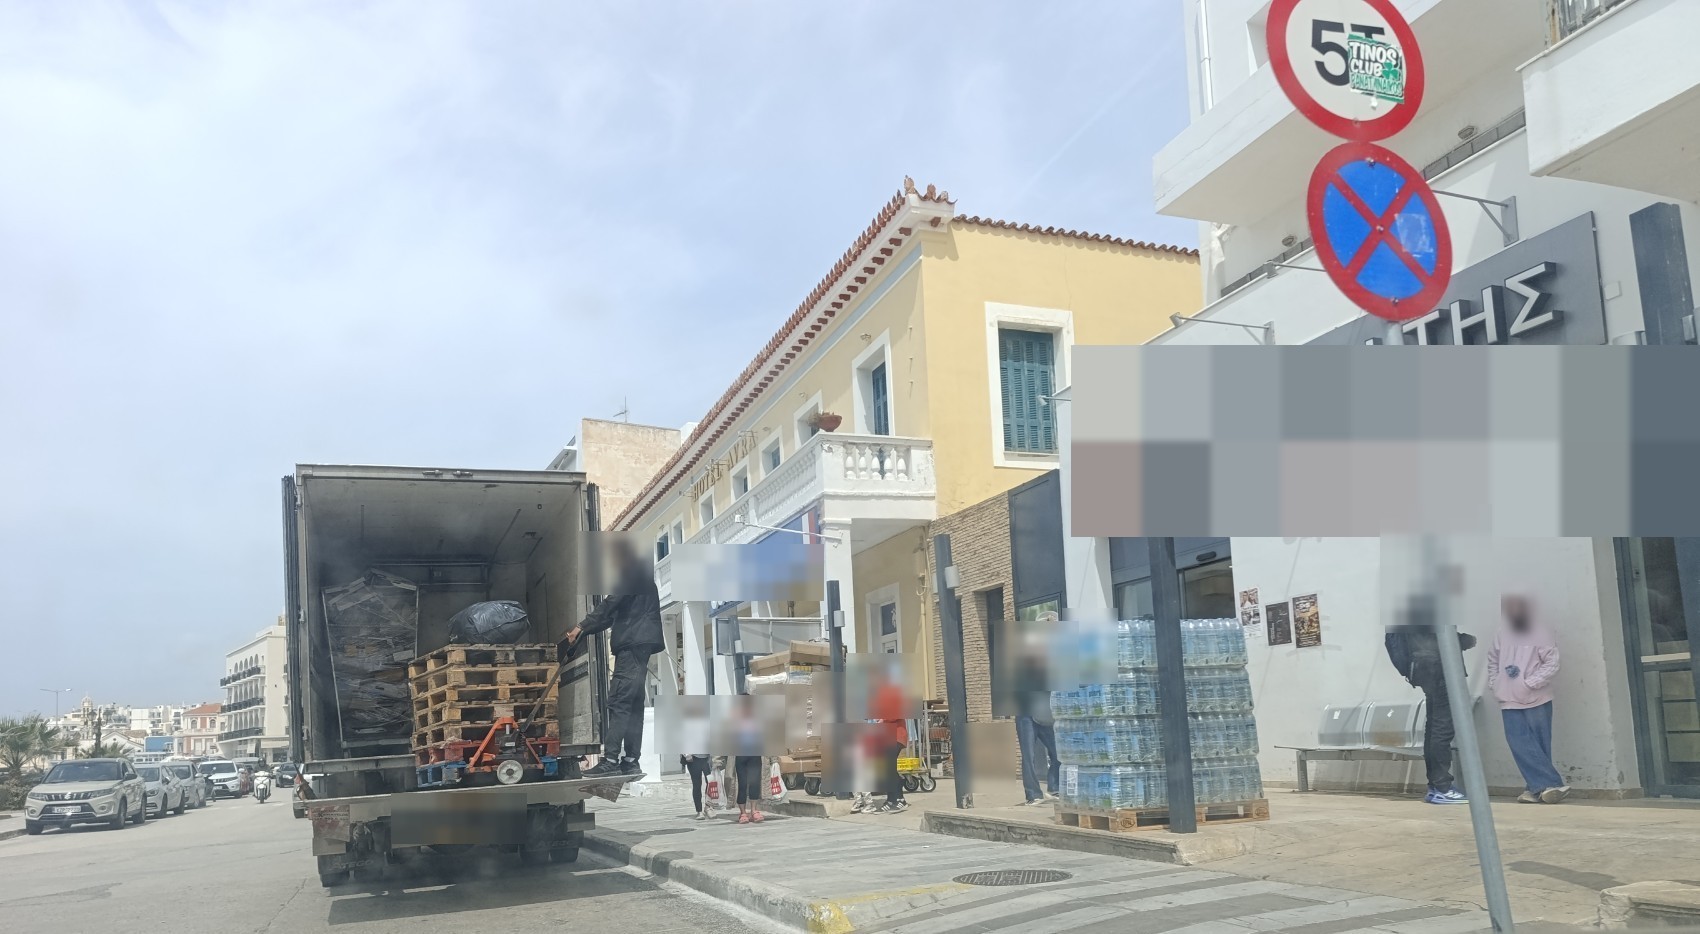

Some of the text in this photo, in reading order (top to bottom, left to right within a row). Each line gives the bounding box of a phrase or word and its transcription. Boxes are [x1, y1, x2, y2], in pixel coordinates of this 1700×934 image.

[1348, 41, 1398, 66] TINOS
[1350, 58, 1383, 77] CLUB
[692, 459, 722, 503] HOTEL
